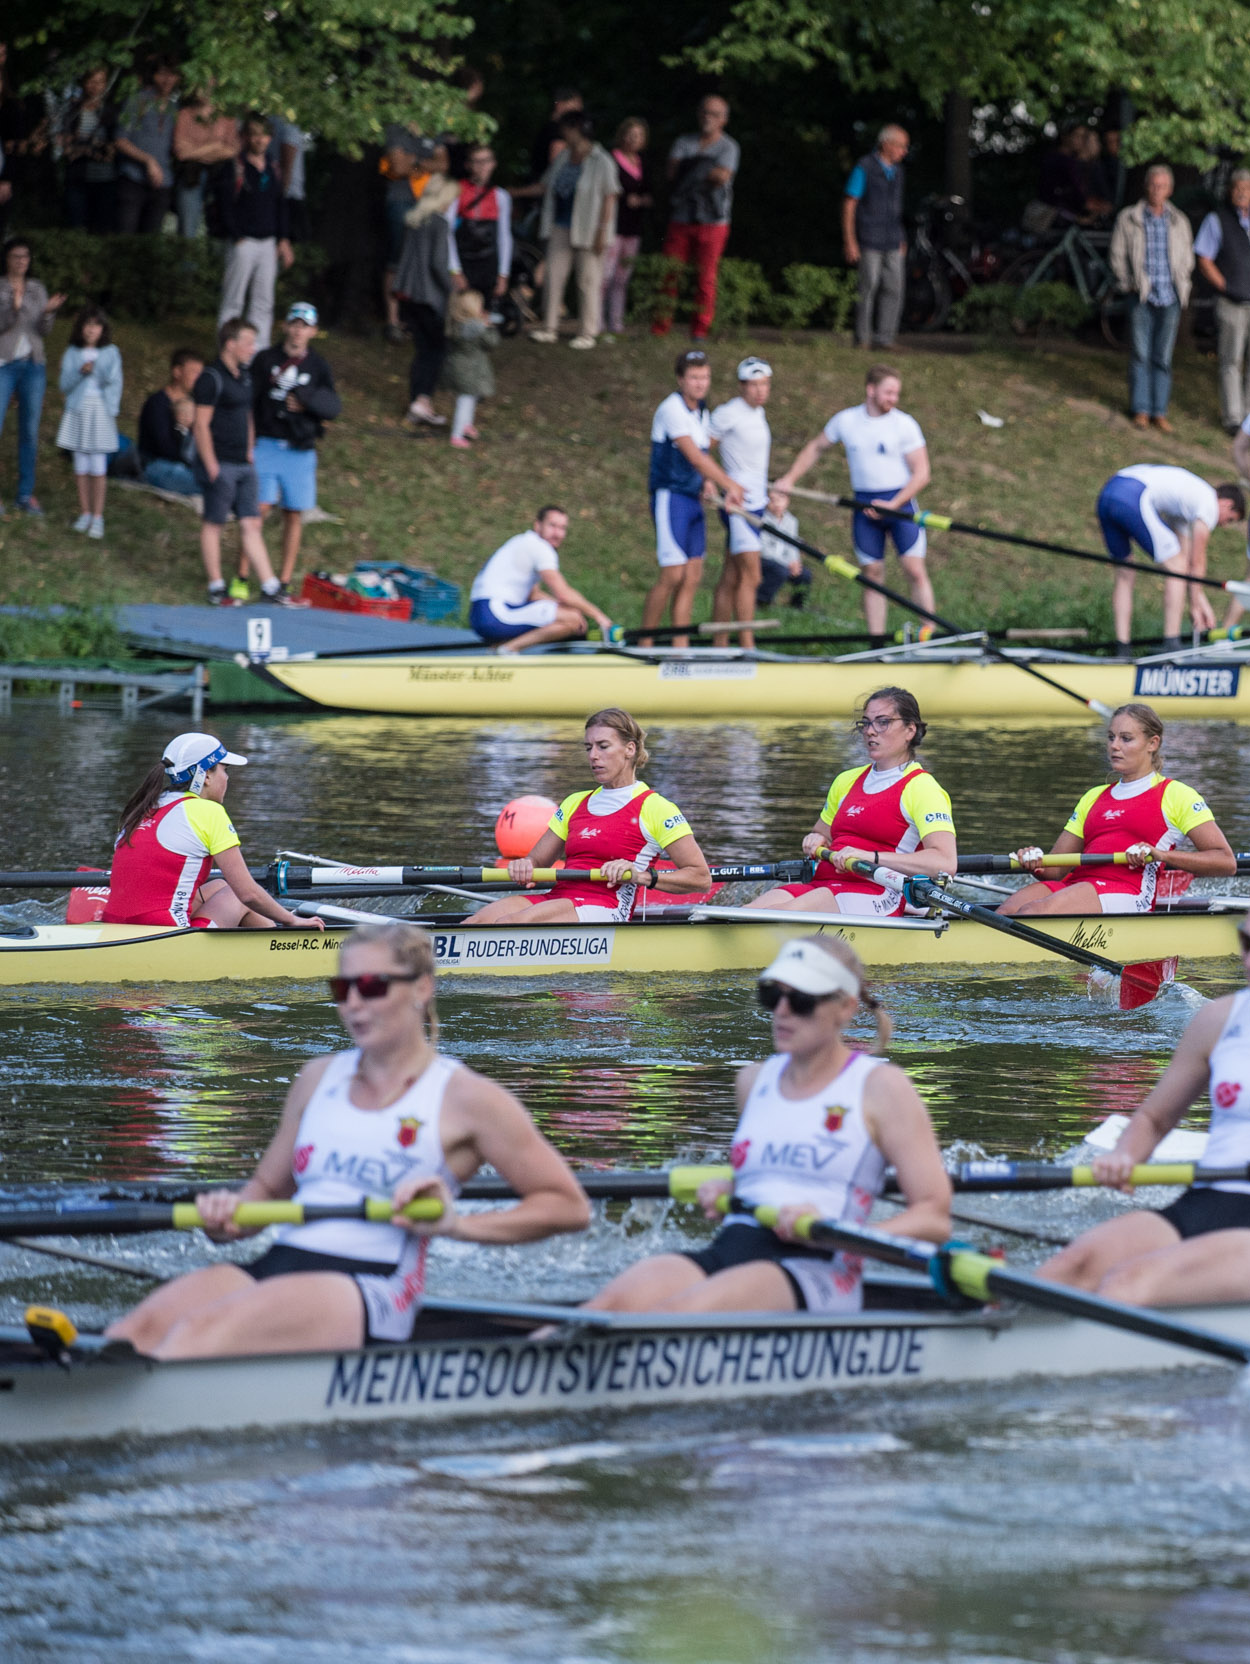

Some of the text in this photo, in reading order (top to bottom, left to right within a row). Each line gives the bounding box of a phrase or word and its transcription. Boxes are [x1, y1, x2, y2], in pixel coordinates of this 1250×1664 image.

[1139, 663, 1234, 696] MÜNSTER
[501, 811, 516, 829] M
[269, 938, 320, 951] Bessel-R.C.
[433, 935, 608, 958] BL RUDER-BUNDESLIGA
[761, 1142, 839, 1170] MEV
[323, 1151, 411, 1190] MEV
[324, 1328, 924, 1409] MEINEBOOTSVERSICHERUNG.DE
